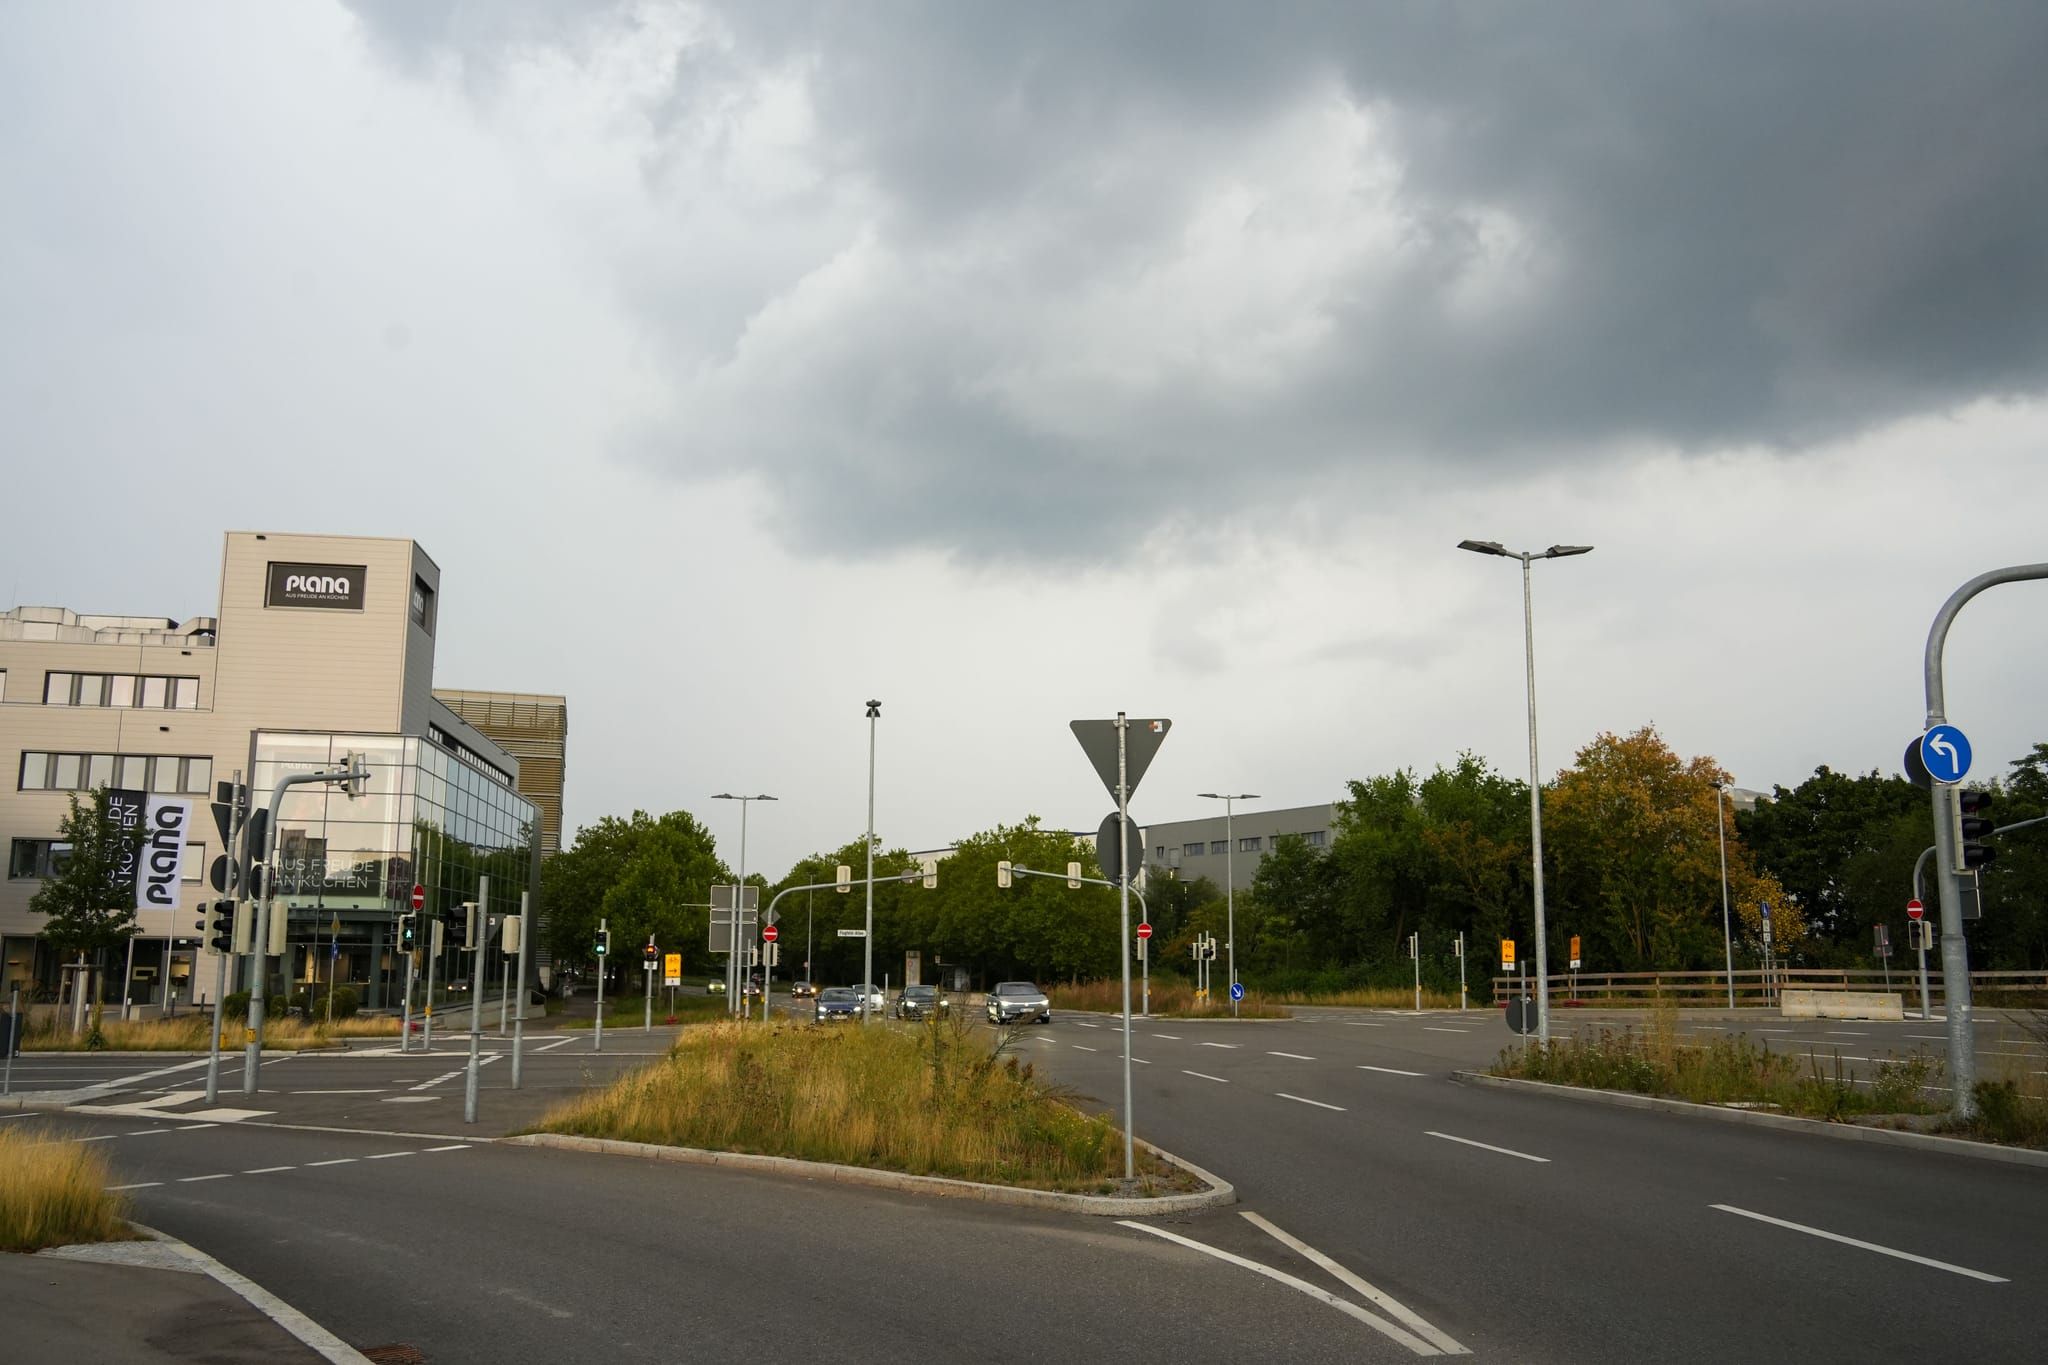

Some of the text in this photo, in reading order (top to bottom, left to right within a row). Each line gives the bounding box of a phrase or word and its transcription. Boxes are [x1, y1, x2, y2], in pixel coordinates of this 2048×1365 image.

[327, 593, 349, 601] KÜCHEN
[276, 858, 374, 873] AUS FREUDE
[274, 872, 368, 888] AN KÜCHEN
